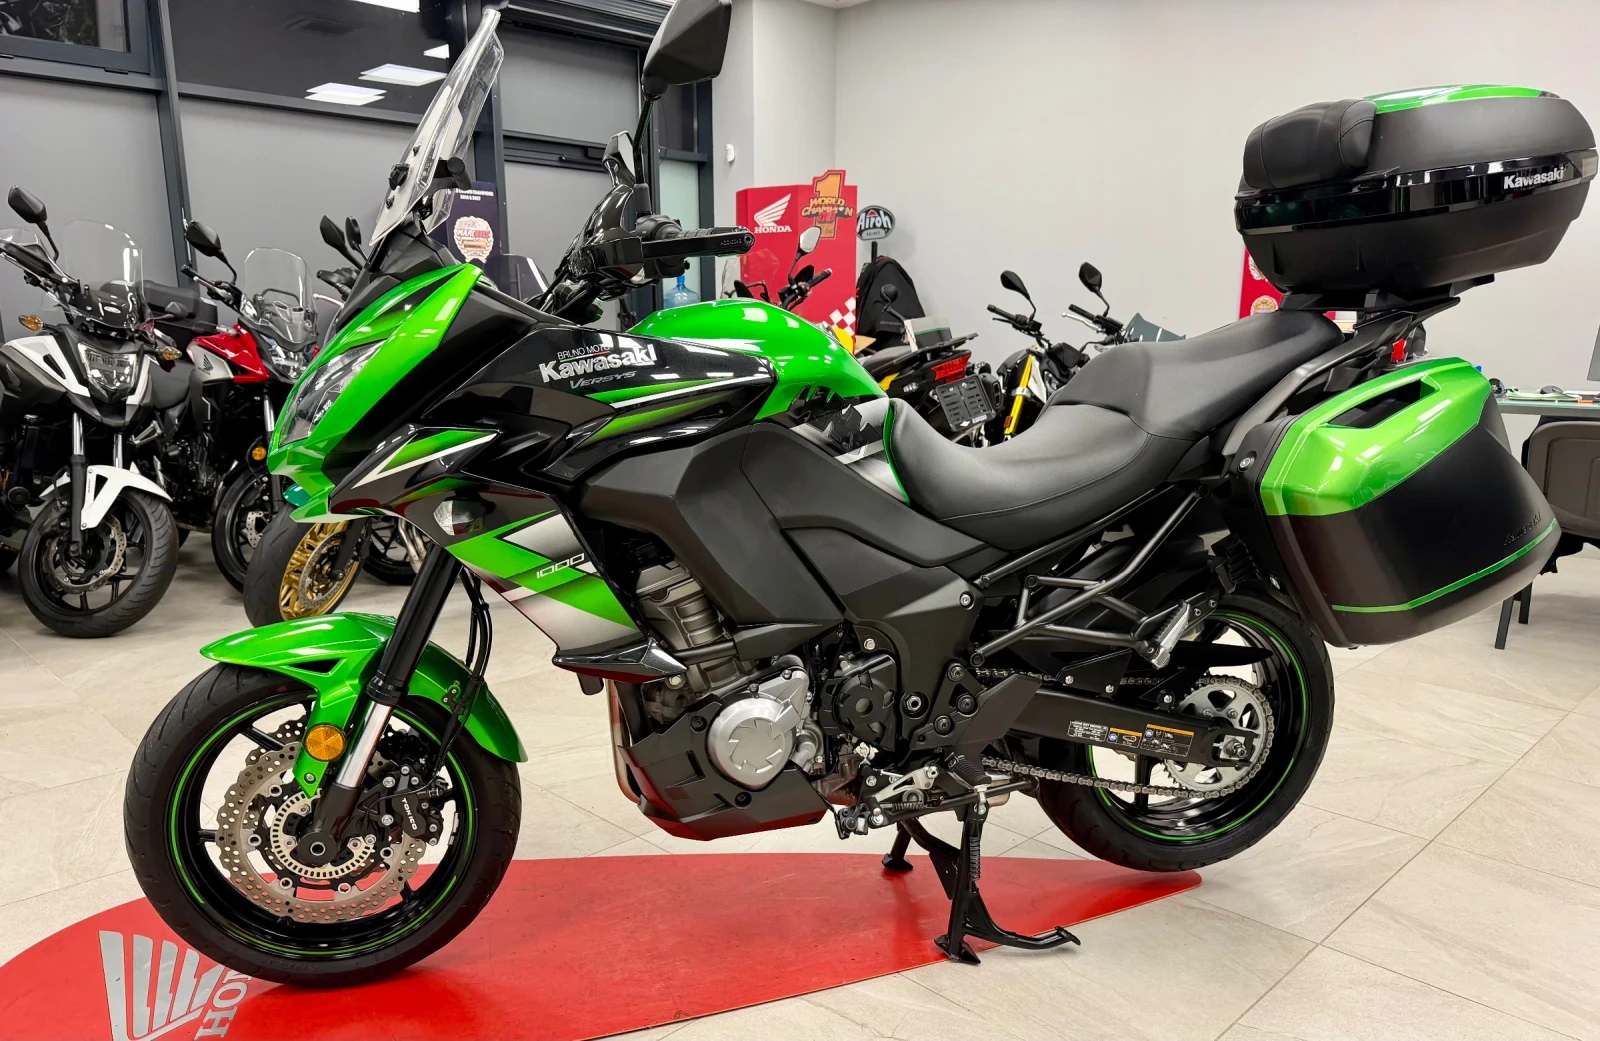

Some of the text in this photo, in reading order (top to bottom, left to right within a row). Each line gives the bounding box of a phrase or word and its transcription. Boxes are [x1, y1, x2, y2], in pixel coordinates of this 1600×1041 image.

[1503, 165, 1564, 190] Kawasaki
[810, 197, 846, 207] WORLD
[856, 209, 892, 233] Airoh
[539, 344, 657, 382] Kawasaki
[557, 347, 586, 360] BRUNO
[569, 370, 637, 390] VERSYS
[536, 552, 585, 579] 1000
[401, 797, 418, 831] TOKICO
